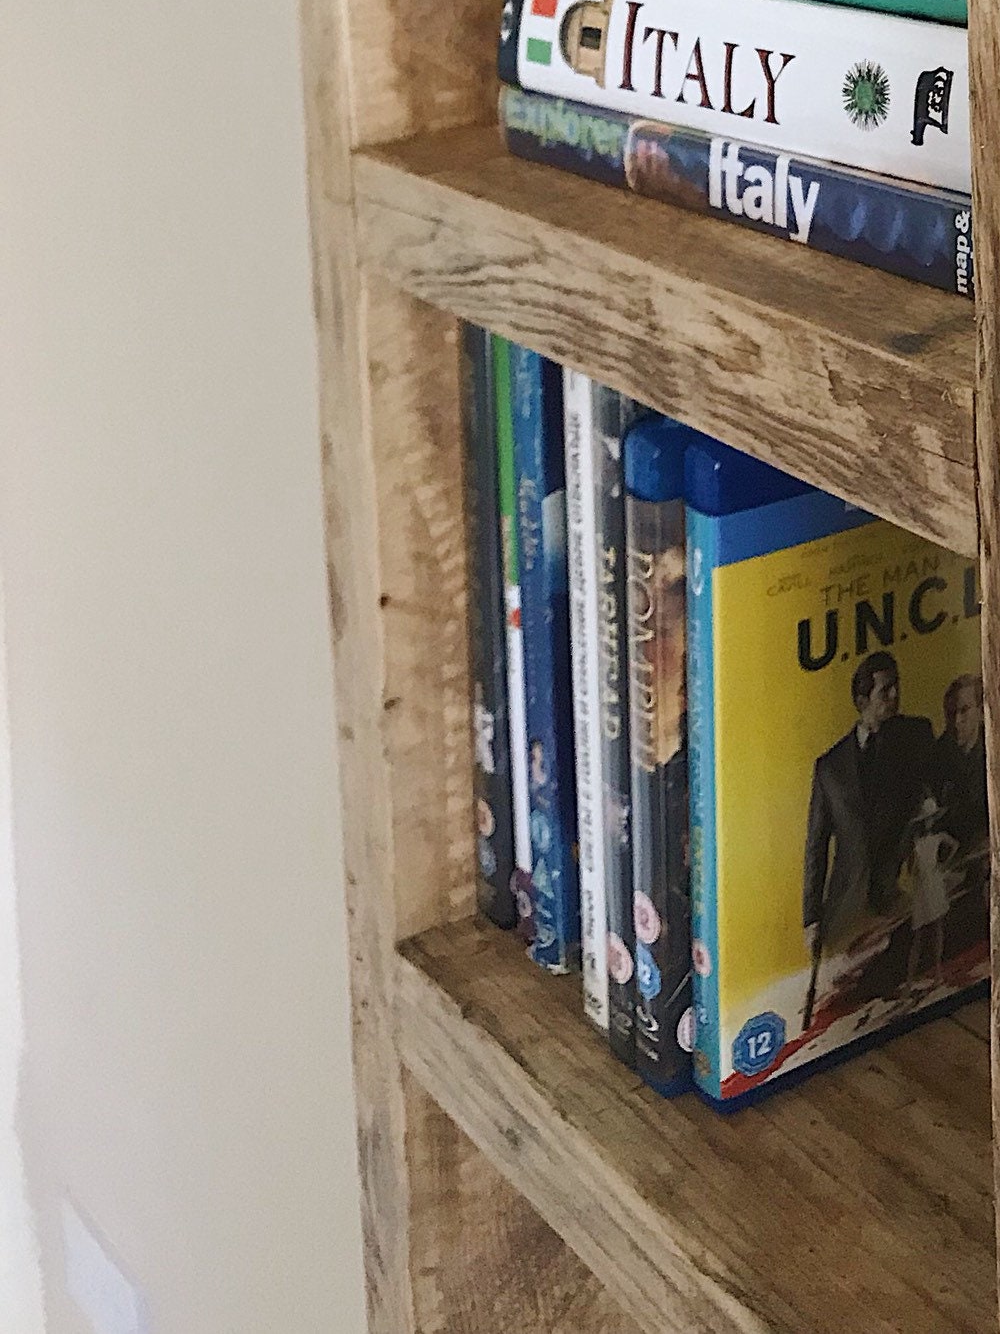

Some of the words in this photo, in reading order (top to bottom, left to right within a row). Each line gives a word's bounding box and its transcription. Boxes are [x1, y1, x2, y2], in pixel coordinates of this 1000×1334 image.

[618, 1, 796, 125] ITALY
[708, 137, 820, 244] Italy
[954, 210, 971, 234] &
[956, 235, 971, 294] map
[820, 575, 870, 605] THE
[882, 555, 941, 586] MAN
[747, 1031, 772, 1059] 12
